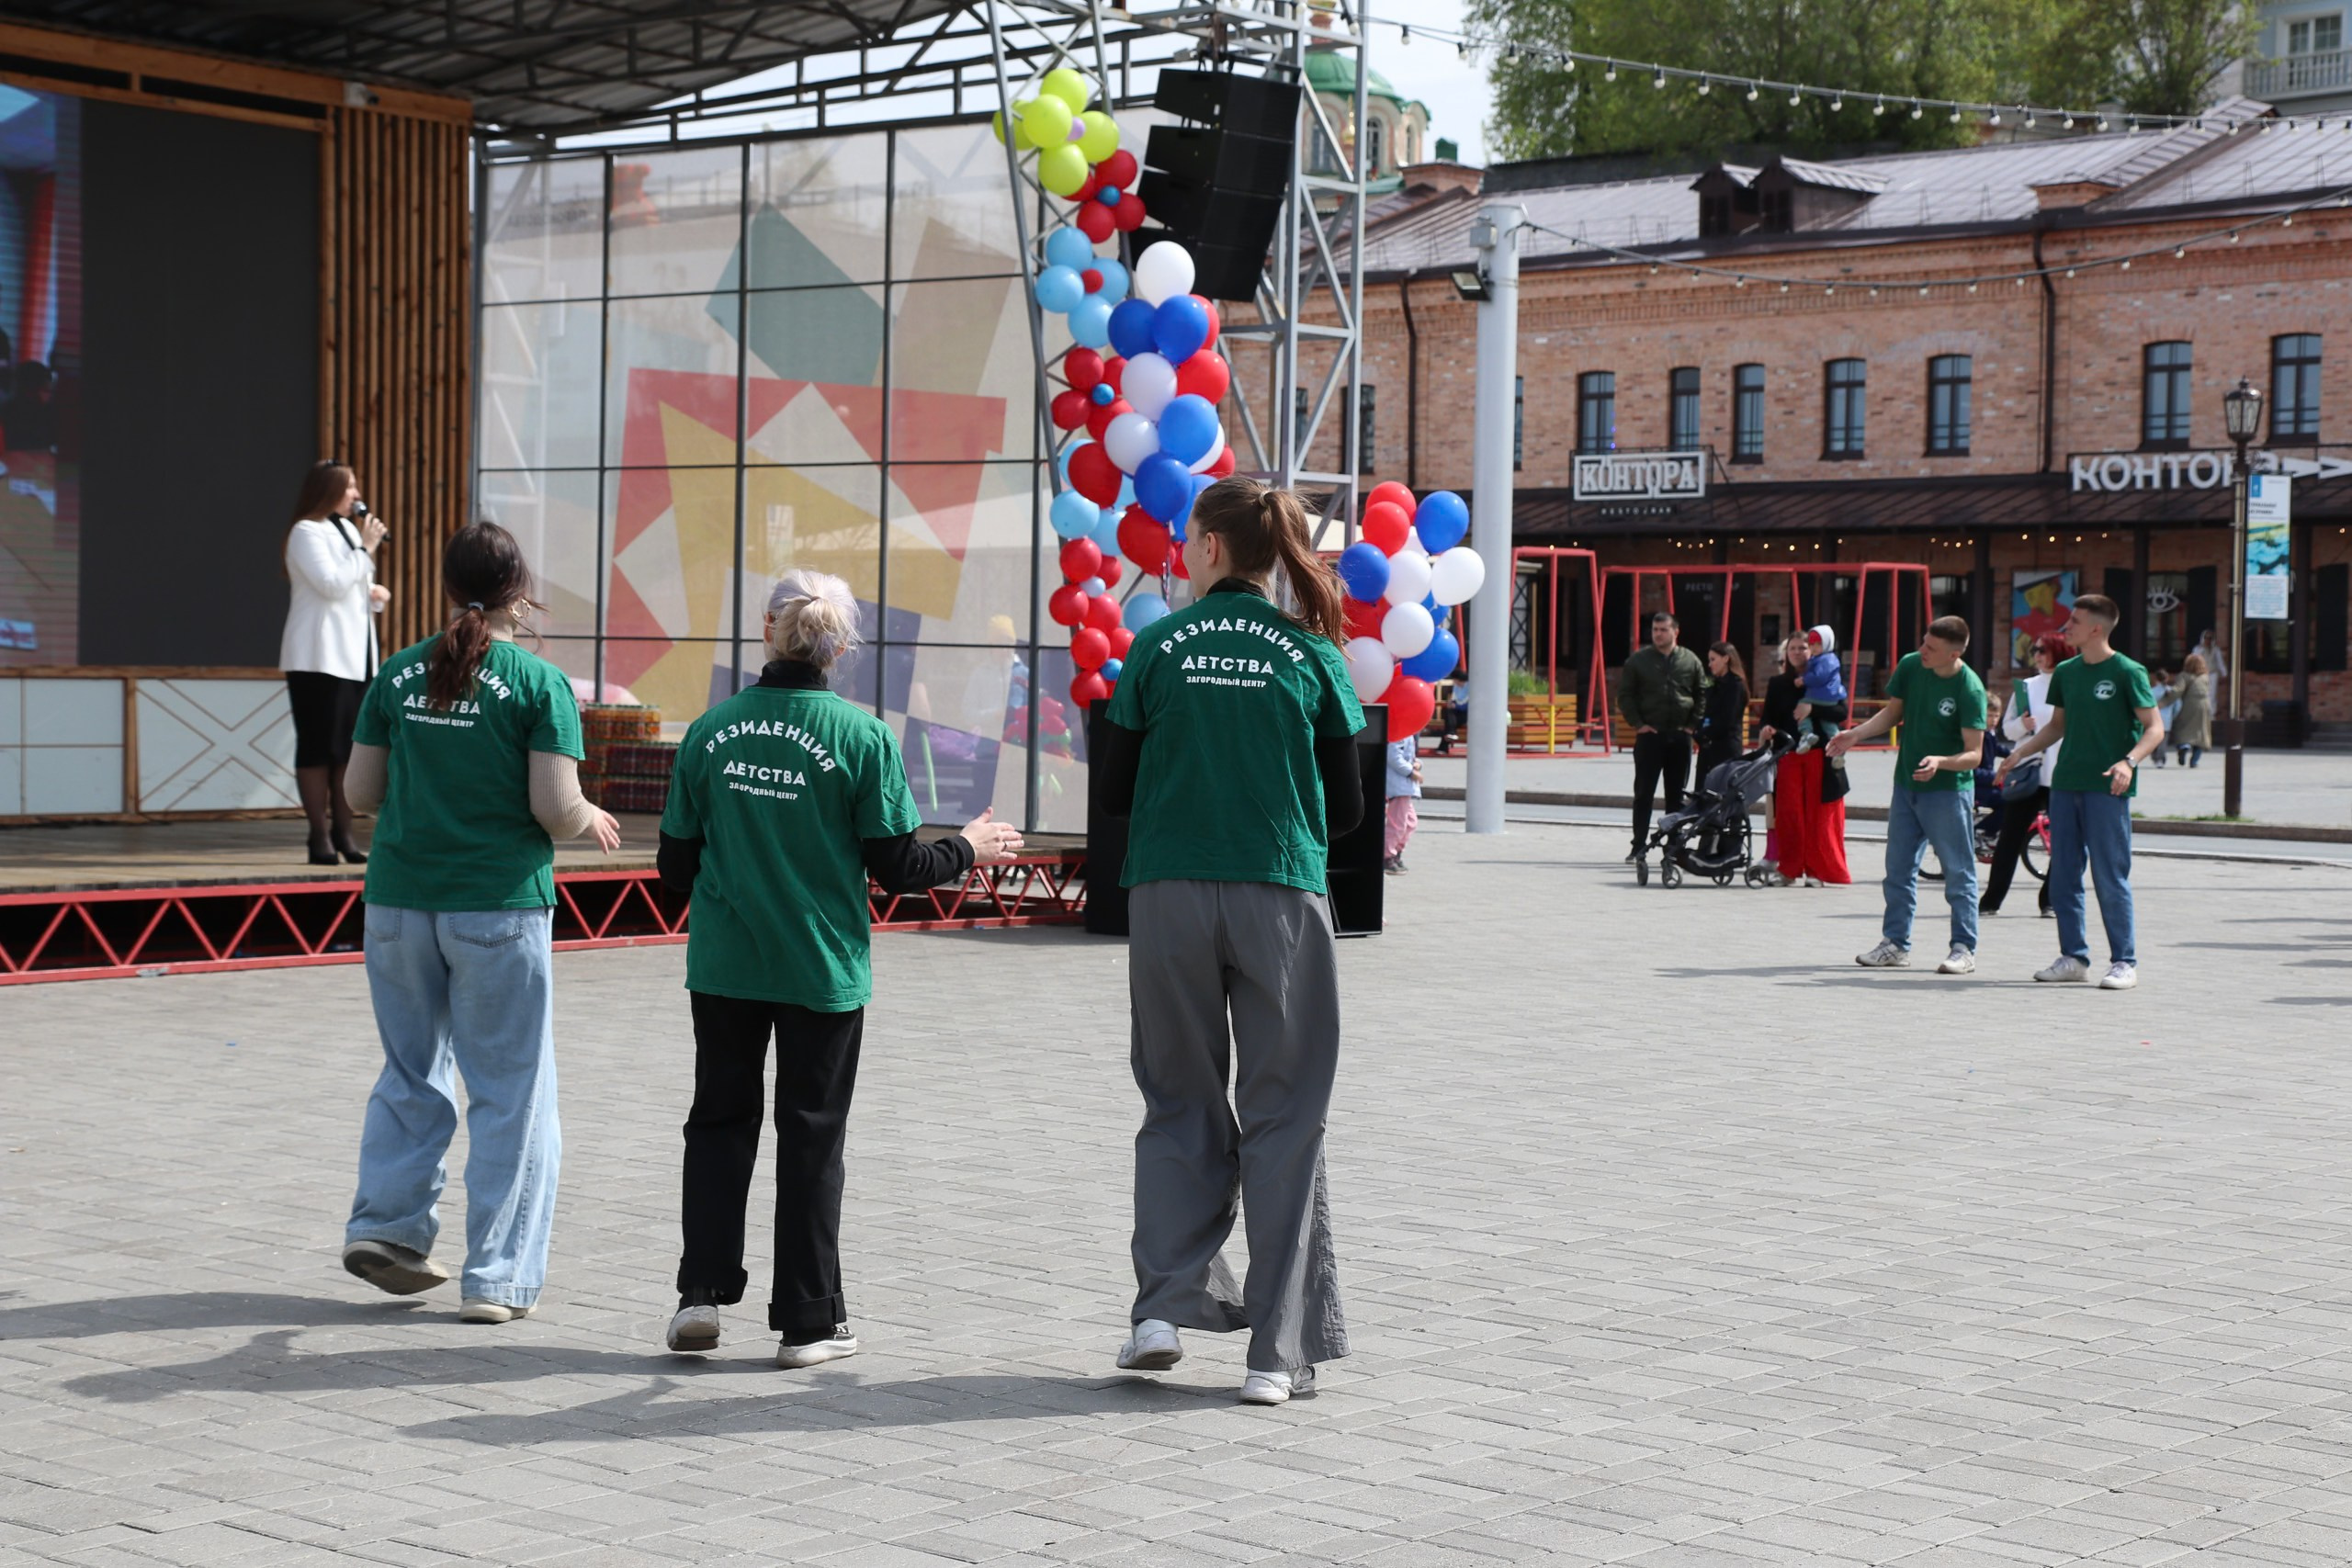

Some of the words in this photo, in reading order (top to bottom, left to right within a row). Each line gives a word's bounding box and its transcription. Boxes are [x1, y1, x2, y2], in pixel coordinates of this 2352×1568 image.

[1580, 459, 1697, 493] КОНТОРА
[1159, 617, 1305, 663] РЕЗИДЕНЦИЯ
[1181, 655, 1274, 675] ДЕТСТВА
[391, 660, 512, 701] РЕЗЦИЯ
[1186, 676, 1239, 685] ЗАГОРОДНЫЙ
[1241, 679, 1267, 688] ЦЕНТР
[403, 694, 481, 715] ДЕТВА
[451, 718, 474, 728] ЦЕНТР
[706, 719, 836, 773] РЕЗИДЕНЦИЯ
[722, 760, 807, 786] ДЕТСТВА
[729, 782, 776, 796] ЗАОРОДНЫЙ
[776, 791, 798, 800] ЦЕНТР
